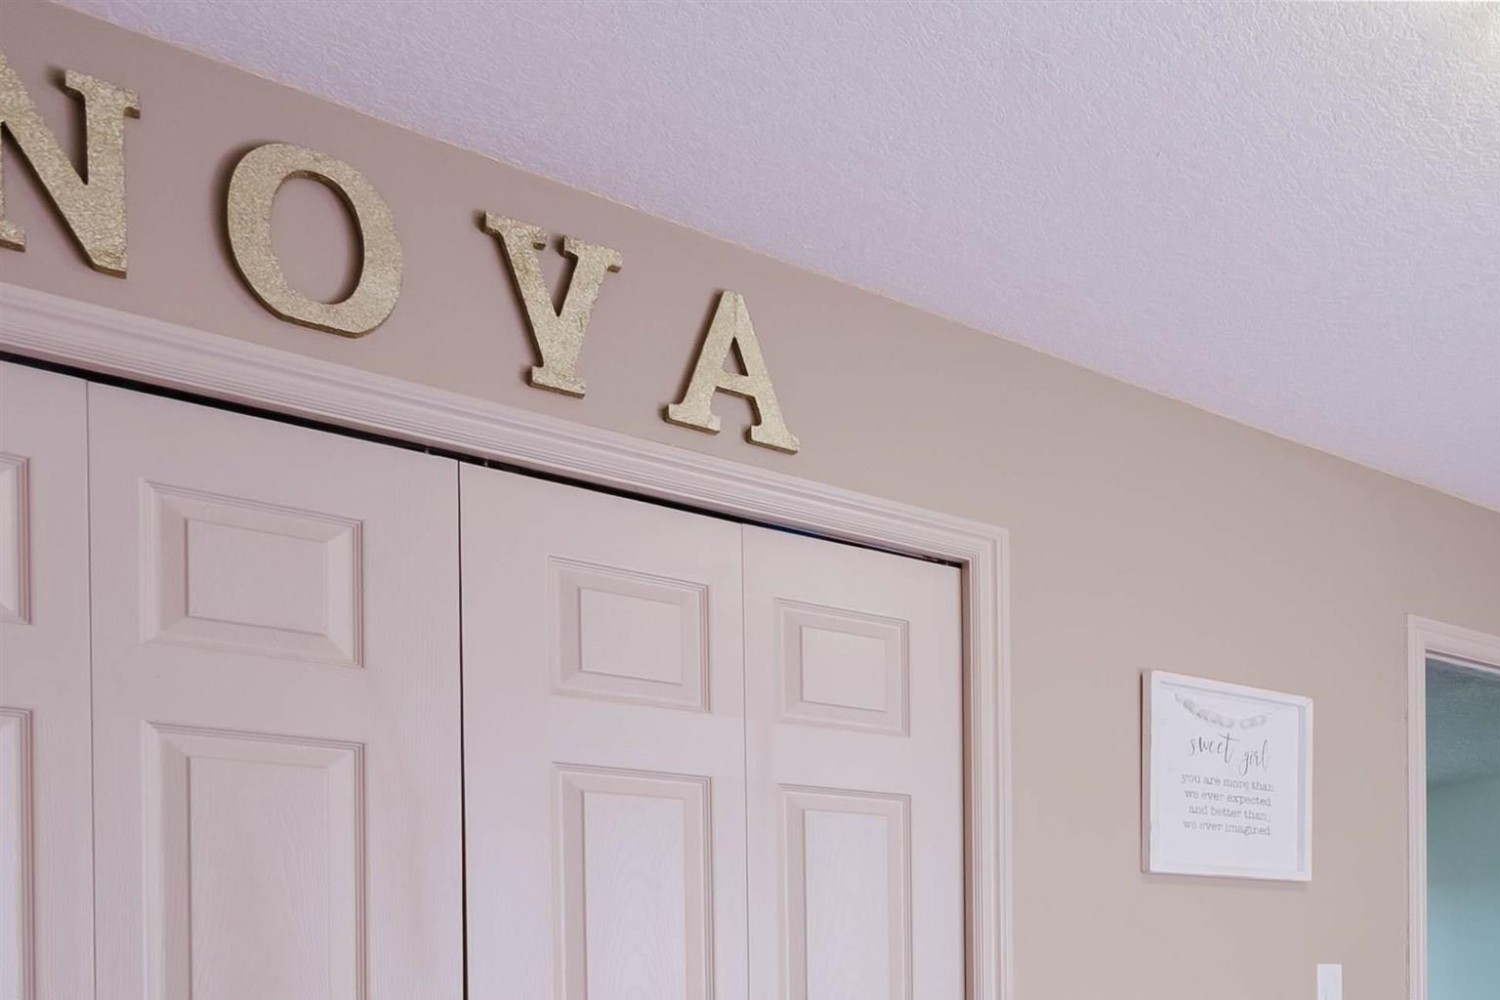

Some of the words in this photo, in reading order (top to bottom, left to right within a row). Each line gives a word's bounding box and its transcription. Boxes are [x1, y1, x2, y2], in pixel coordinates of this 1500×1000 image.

[1187, 732, 1241, 763] sweet
[1239, 739, 1269, 777] girl
[1180, 773, 1201, 785] you
[1203, 775, 1221, 786] are
[1223, 778, 1250, 790] more
[1251, 780, 1274, 792] than
[1184, 789, 1200, 800] we
[1201, 791, 1225, 802] ever
[1226, 794, 1272, 807] expected
[1188, 804, 1209, 816] and
[1210, 806, 1242, 818] better
[1182, 819, 1198, 830] we
[1199, 821, 1223, 832] ever
